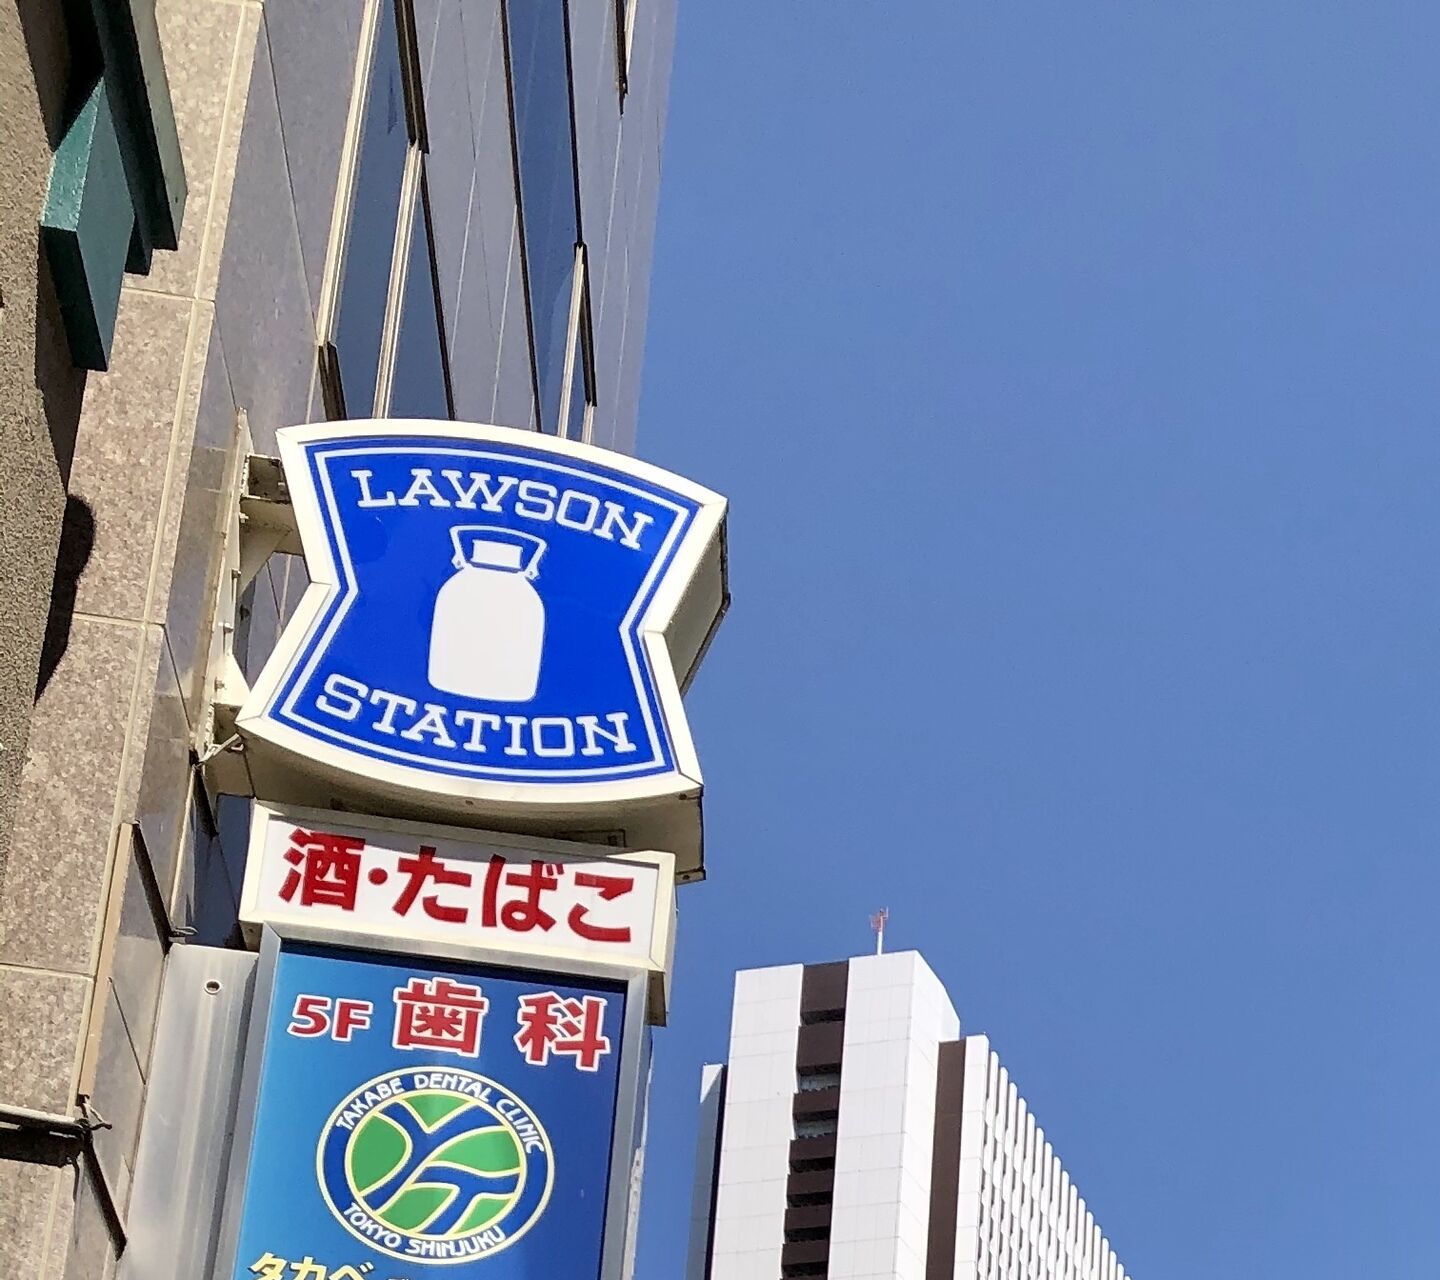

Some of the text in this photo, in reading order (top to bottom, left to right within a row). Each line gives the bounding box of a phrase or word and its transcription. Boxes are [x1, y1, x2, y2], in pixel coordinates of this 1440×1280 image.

[351, 468, 655, 551] LAWSON
[314, 673, 638, 758] STATION
[287, 994, 373, 1042] 5F
[336, 1072, 545, 1155] TAKABE DENTAL CLINIC
[343, 1202, 507, 1257] TOKYO SHINJUKU
